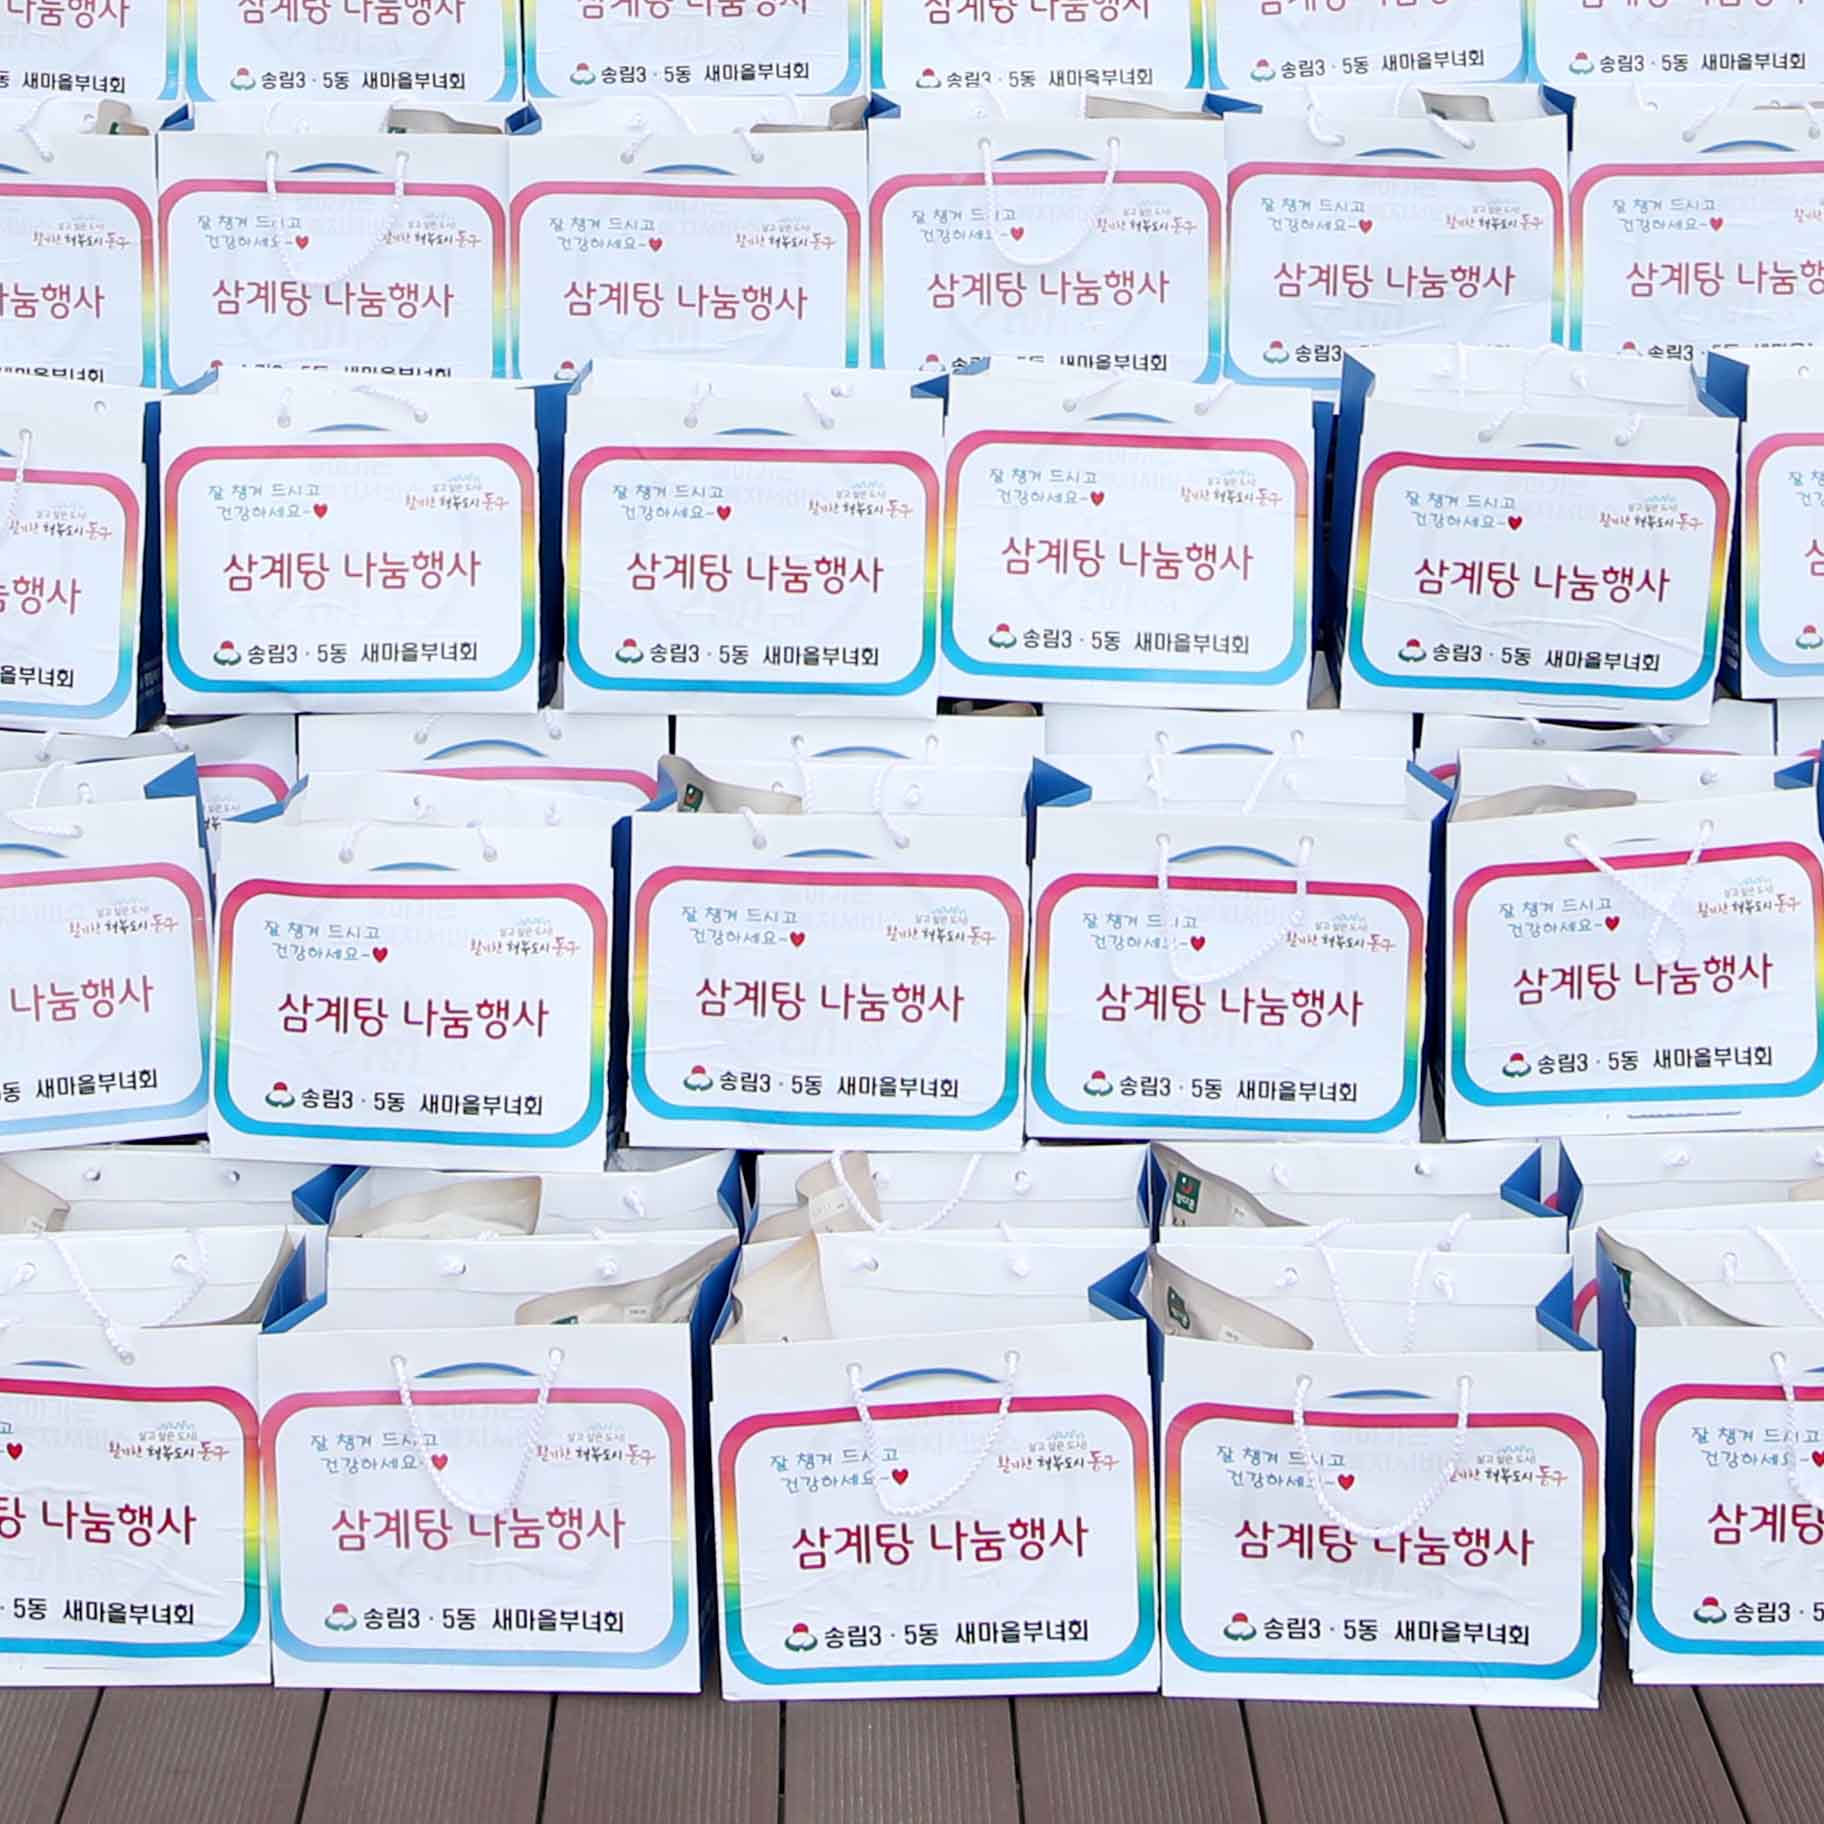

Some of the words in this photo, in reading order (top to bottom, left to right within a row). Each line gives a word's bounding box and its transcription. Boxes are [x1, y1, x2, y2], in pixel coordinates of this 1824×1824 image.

[704, 62, 808, 82] 새마을부녀회
[212, 280, 312, 317] 삼계탕
[325, 282, 454, 319] 나눔행사
[928, 272, 1027, 308] 삼계탕
[1040, 270, 1170, 306] 나눔행사
[1274, 263, 1374, 299] 삼계탕
[1387, 265, 1516, 298] 나눔행사
[1626, 262, 1725, 297] 삼계탕
[564, 281, 664, 318] 삼계탕
[678, 284, 808, 321] 나눔행사
[224, 552, 330, 591] 삼계탕
[345, 550, 481, 589] 나눔행사
[627, 553, 732, 592] 삼계탕
[747, 555, 884, 594] 나눔행사
[1002, 537, 1105, 577] 삼계탕
[1120, 541, 1254, 581] 나눔행사
[1415, 559, 1520, 598] 삼계탕
[1534, 565, 1670, 603] 나눔행사
[763, 646, 878, 666] 새마을부녀회
[682, 906, 698, 923] 잘
[746, 908, 798, 924] 드시고
[11, 975, 154, 1022] 나눔행사
[1514, 962, 1620, 1005] 삼계탕
[1635, 953, 1773, 995] 나눔행사
[278, 994, 388, 1037] 삼계탕
[404, 999, 549, 1039] 나눔행사
[696, 978, 806, 1021] 삼계탕
[821, 983, 964, 1023] 나눔행사
[1096, 984, 1206, 1024] 삼계탕
[1221, 987, 1363, 1028] 나눔행사
[36, 1069, 157, 1098] 새마을부녀회
[42, 1500, 196, 1547] 나눔행사
[793, 1523, 914, 1570] 삼계탕
[931, 1516, 1088, 1562] 나눔행사
